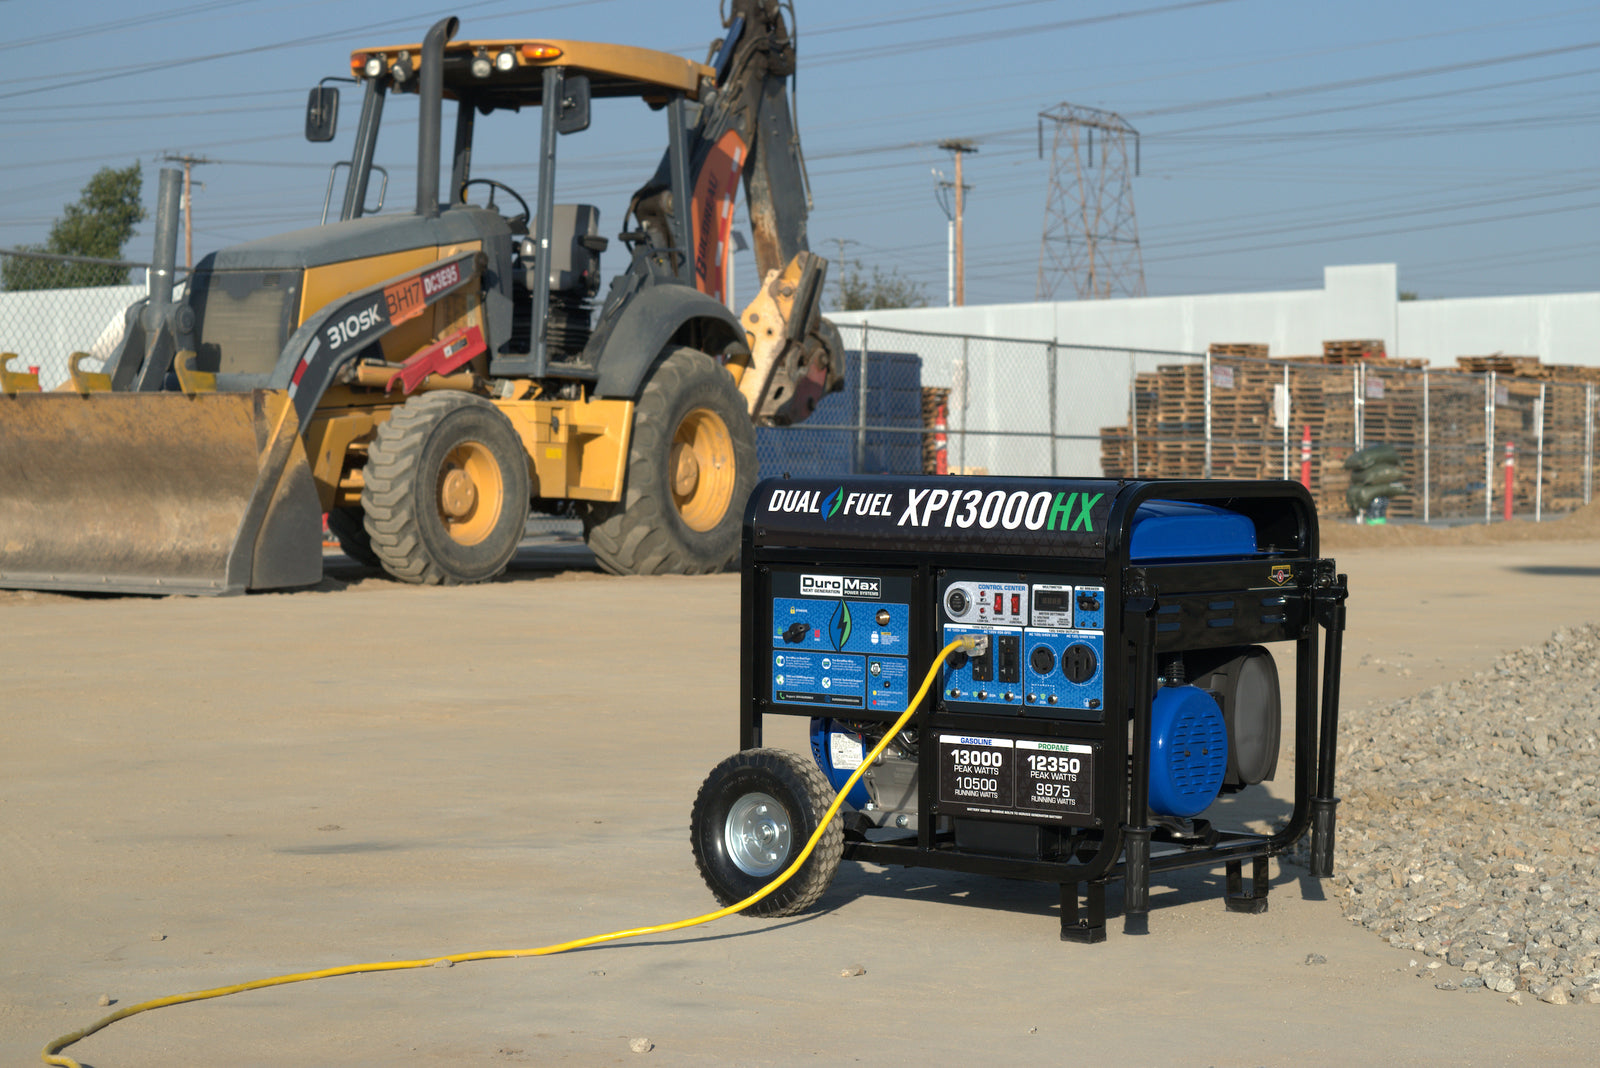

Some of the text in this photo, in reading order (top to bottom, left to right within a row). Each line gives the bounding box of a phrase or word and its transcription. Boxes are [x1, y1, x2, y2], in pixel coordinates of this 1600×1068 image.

[424, 264, 459, 295] DC3E95
[386, 282, 420, 316] BH17
[327, 303, 381, 350] 310SK
[768, 488, 1105, 532] DUAL FUEL XP13000HX
[1038, 743, 1069, 751] PROPANE
[951, 749, 1002, 767] 13000
[1027, 755, 1080, 773] 12350
[954, 765, 999, 775] PEAK WATTS
[1031, 771, 1076, 782] PEAK WATTS
[956, 776, 997, 791] 10500
[1036, 783, 1070, 798] 9975
[955, 789, 979, 797] RUNNING
[1031, 796, 1056, 804] RUNNING
